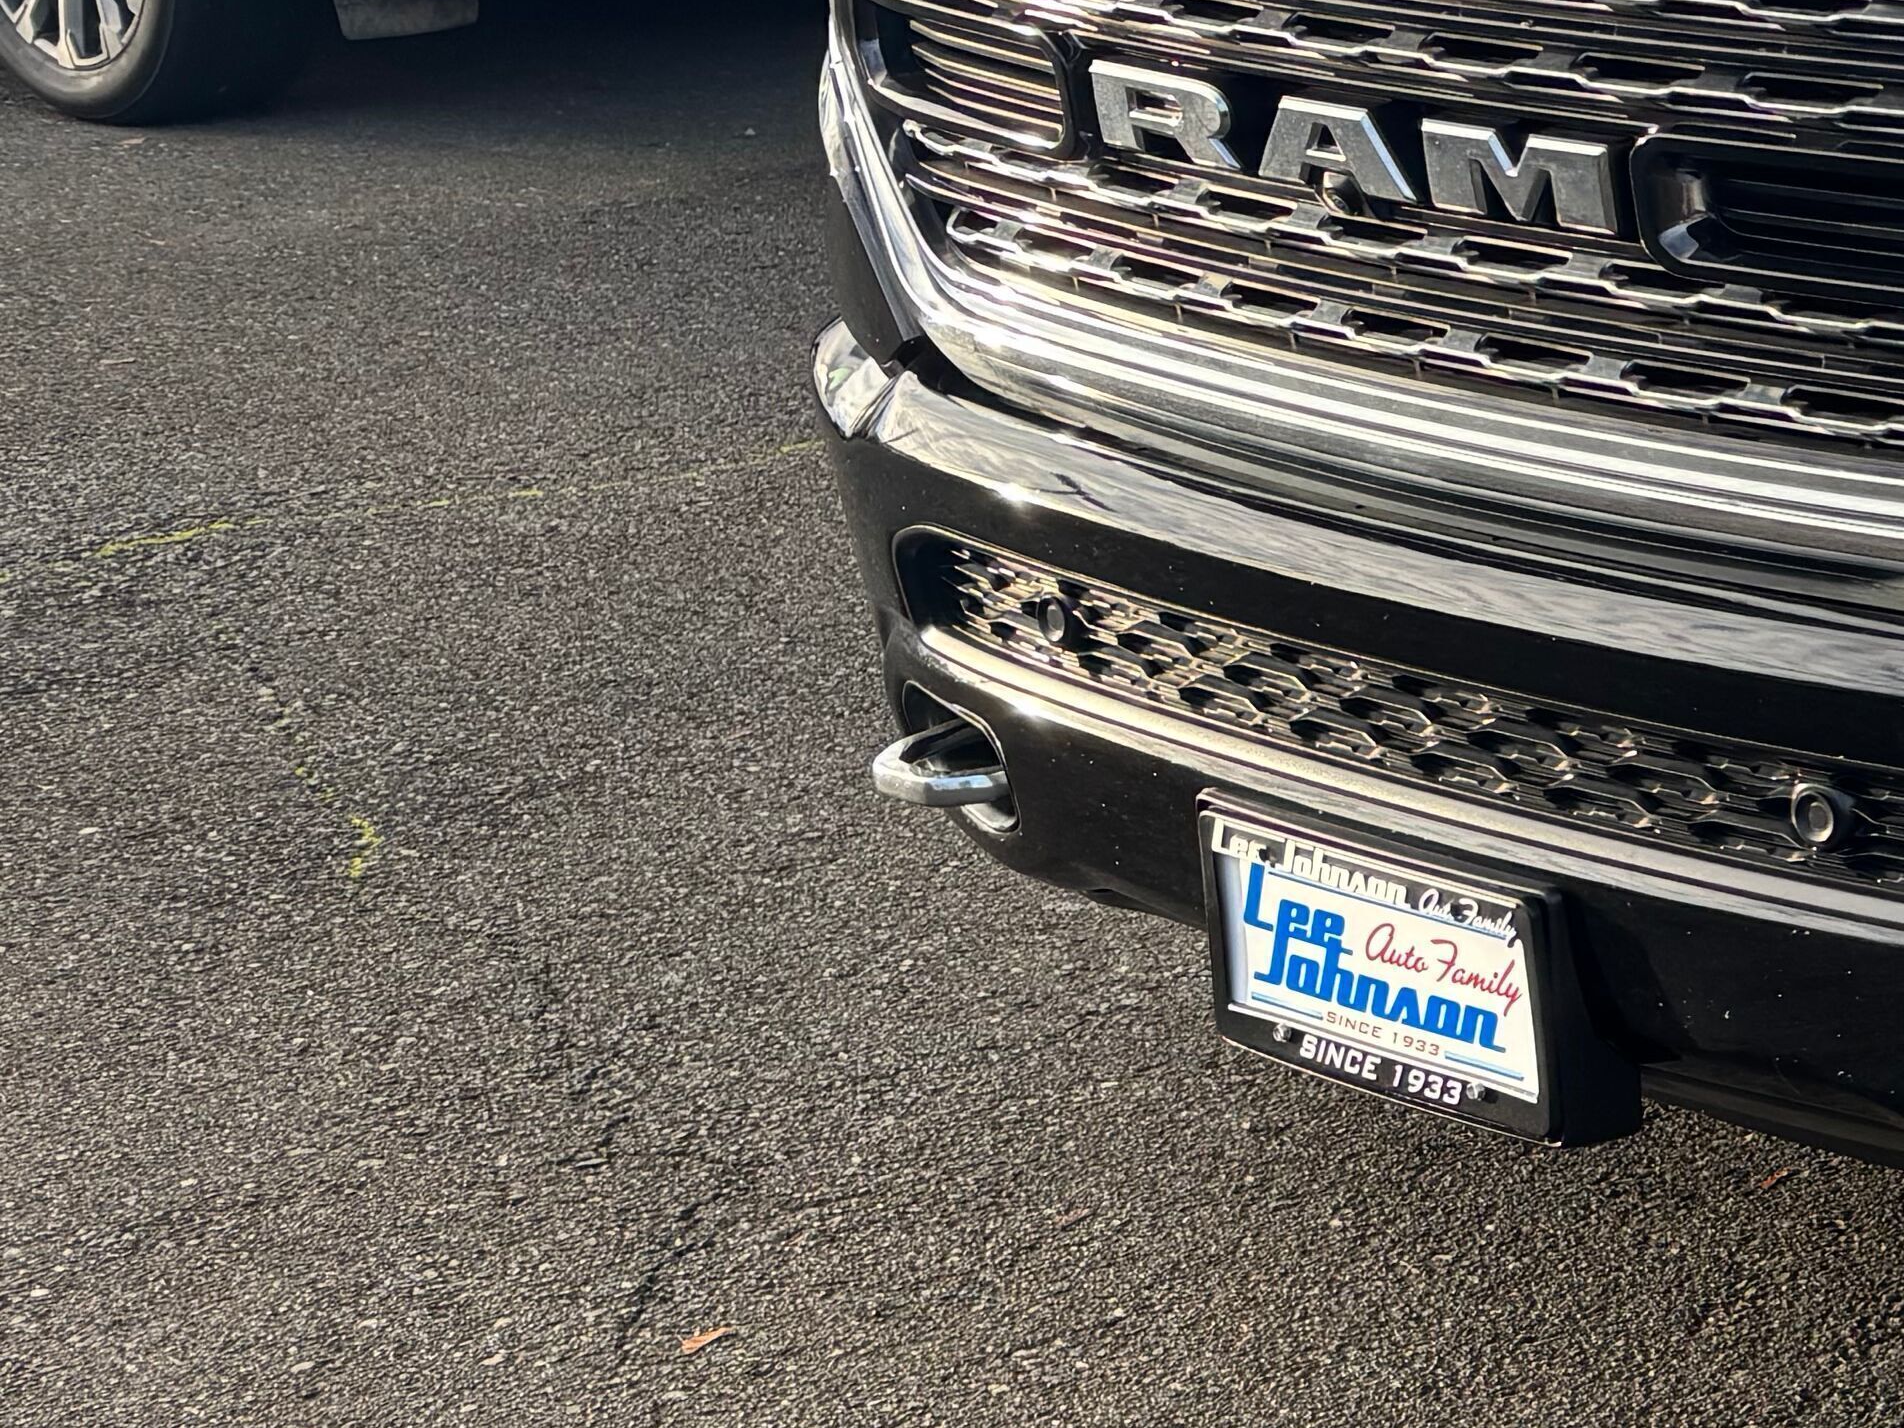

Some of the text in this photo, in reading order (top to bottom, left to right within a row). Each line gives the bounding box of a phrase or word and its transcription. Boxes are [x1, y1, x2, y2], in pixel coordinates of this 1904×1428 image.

[1088, 59, 1619, 235] RAM
[1211, 818, 1267, 864] Lee
[1266, 838, 1412, 908] Johnson
[1242, 861, 1353, 956] Lee
[1254, 934, 1506, 1054] Johnson
[1365, 922, 1522, 1017] Auto Family
[1299, 1034, 1463, 1106] SINCE 1933
[1325, 1010, 1441, 1057] SINCE 1933
